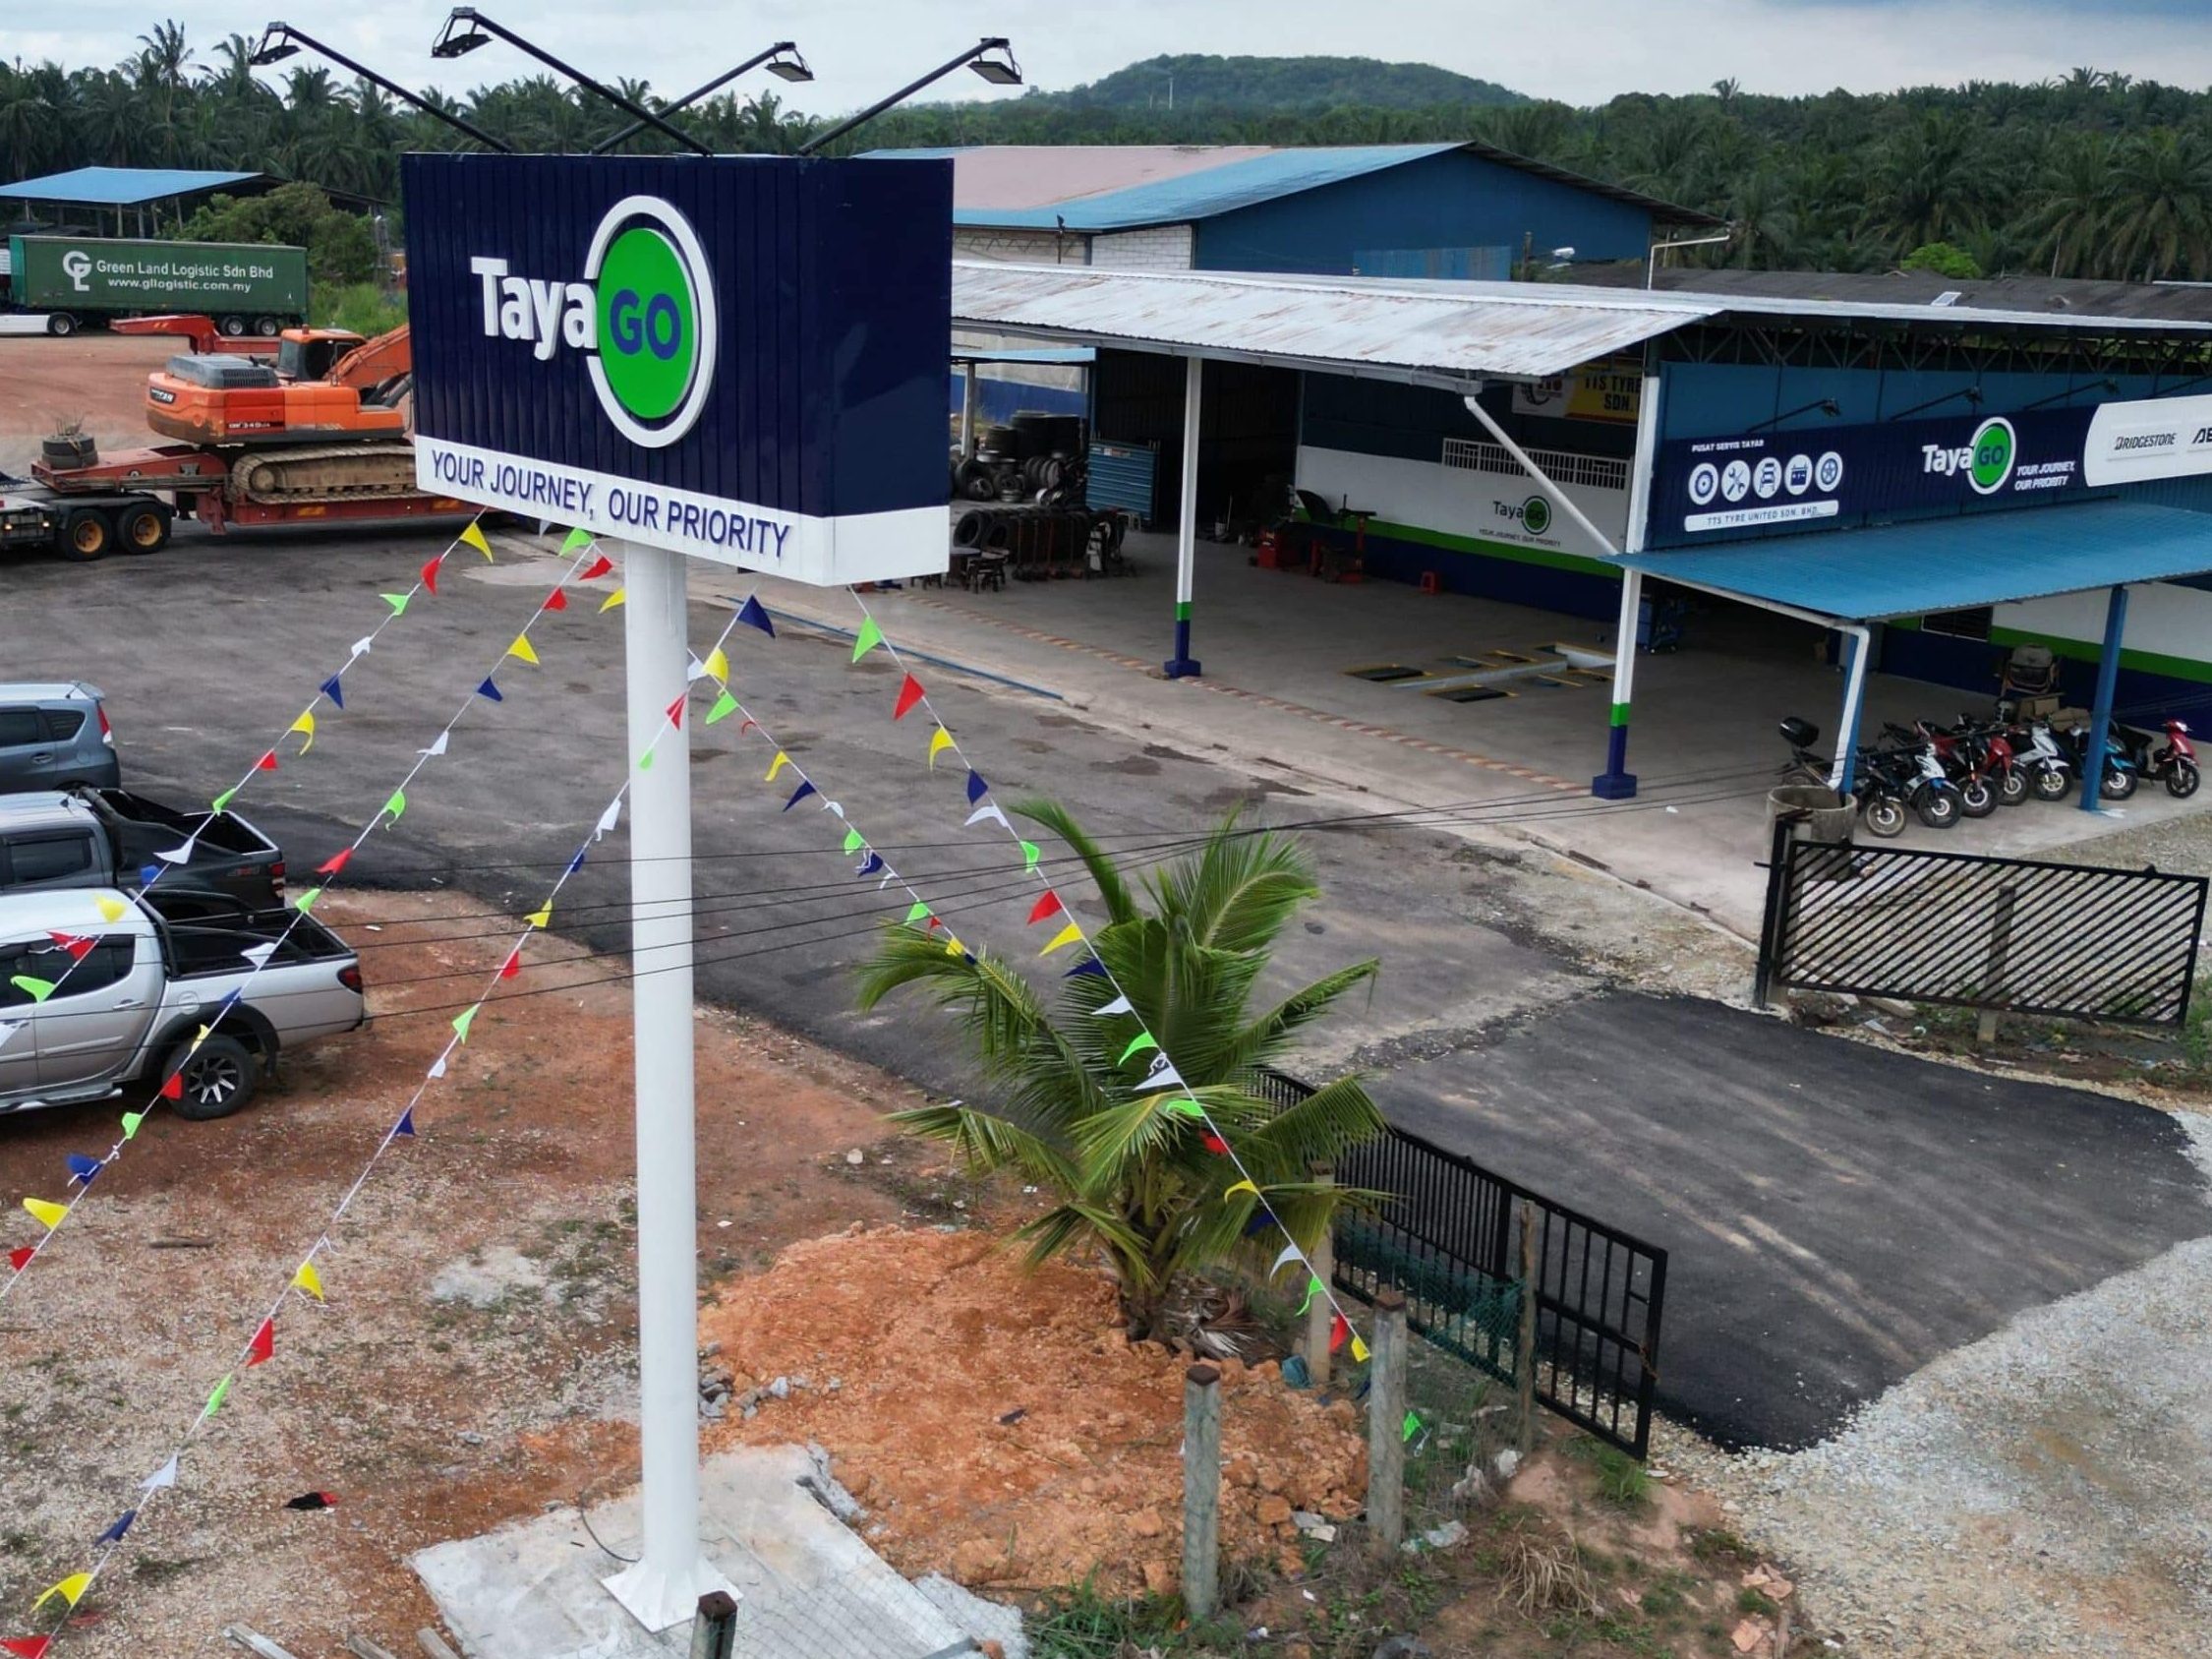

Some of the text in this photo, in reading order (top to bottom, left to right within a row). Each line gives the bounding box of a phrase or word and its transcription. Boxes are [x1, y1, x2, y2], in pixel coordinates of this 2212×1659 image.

[96, 260, 273, 278] Green Land Logistic Sdn Bhd
[107, 278, 252, 292] www.gllogistic.com.my
[471, 256, 681, 361] Taya GO
[2114, 433, 2177, 450] BRIDGESTONE
[1922, 444, 2005, 476] Taya GO
[2016, 464, 2039, 477] YOUR
[2014, 476, 2068, 491] OUR PRIORITY
[432, 449, 790, 558] YOUR JOURNEY, OUR PRIORITY
[1492, 501, 1523, 519] Taya
[1707, 516, 1721, 526] TTS
[1724, 513, 1745, 523] TYRE
[1748, 510, 1777, 521] UNITED
